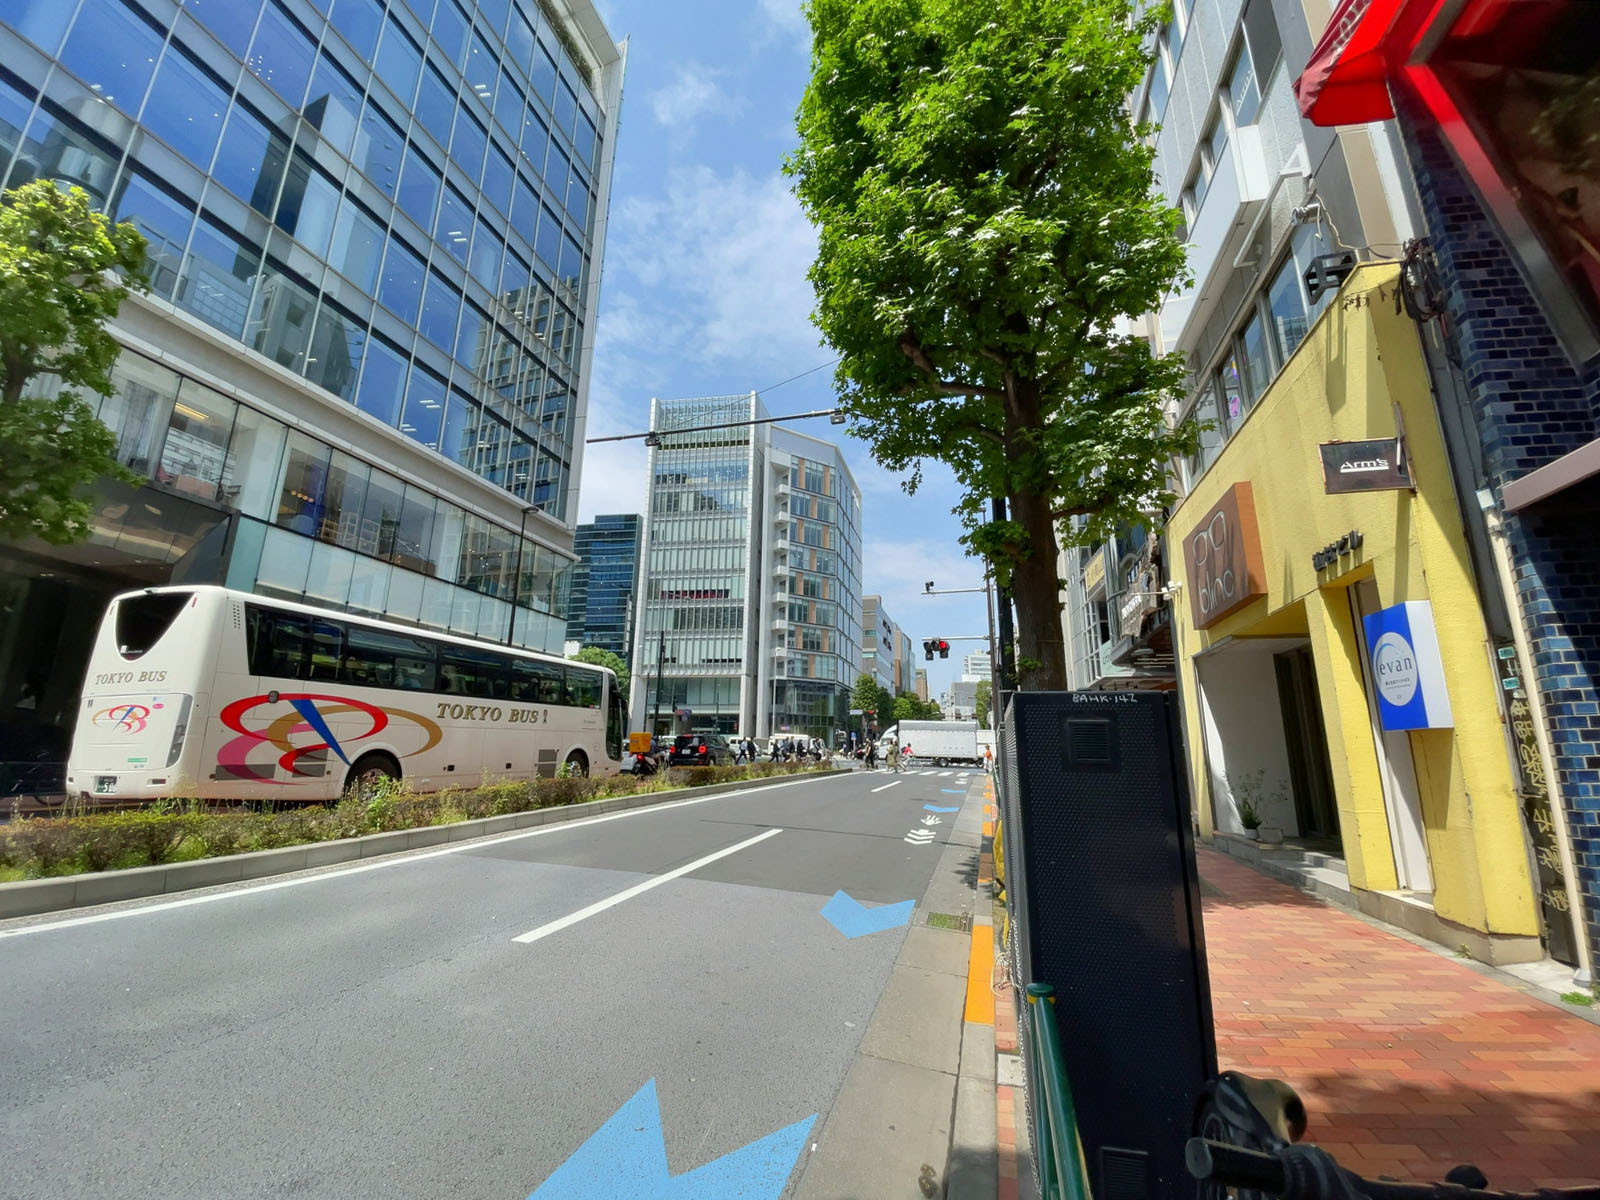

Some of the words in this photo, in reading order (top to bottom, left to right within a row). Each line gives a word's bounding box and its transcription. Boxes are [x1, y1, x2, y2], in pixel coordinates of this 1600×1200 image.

[1340, 458, 1389, 473] Arm's
[1379, 656, 1413, 676] evan
[95, 672, 134, 685] TOKYO
[137, 670, 168, 683] BUS
[437, 702, 502, 721] TOKYO
[508, 707, 539, 724] BUS
